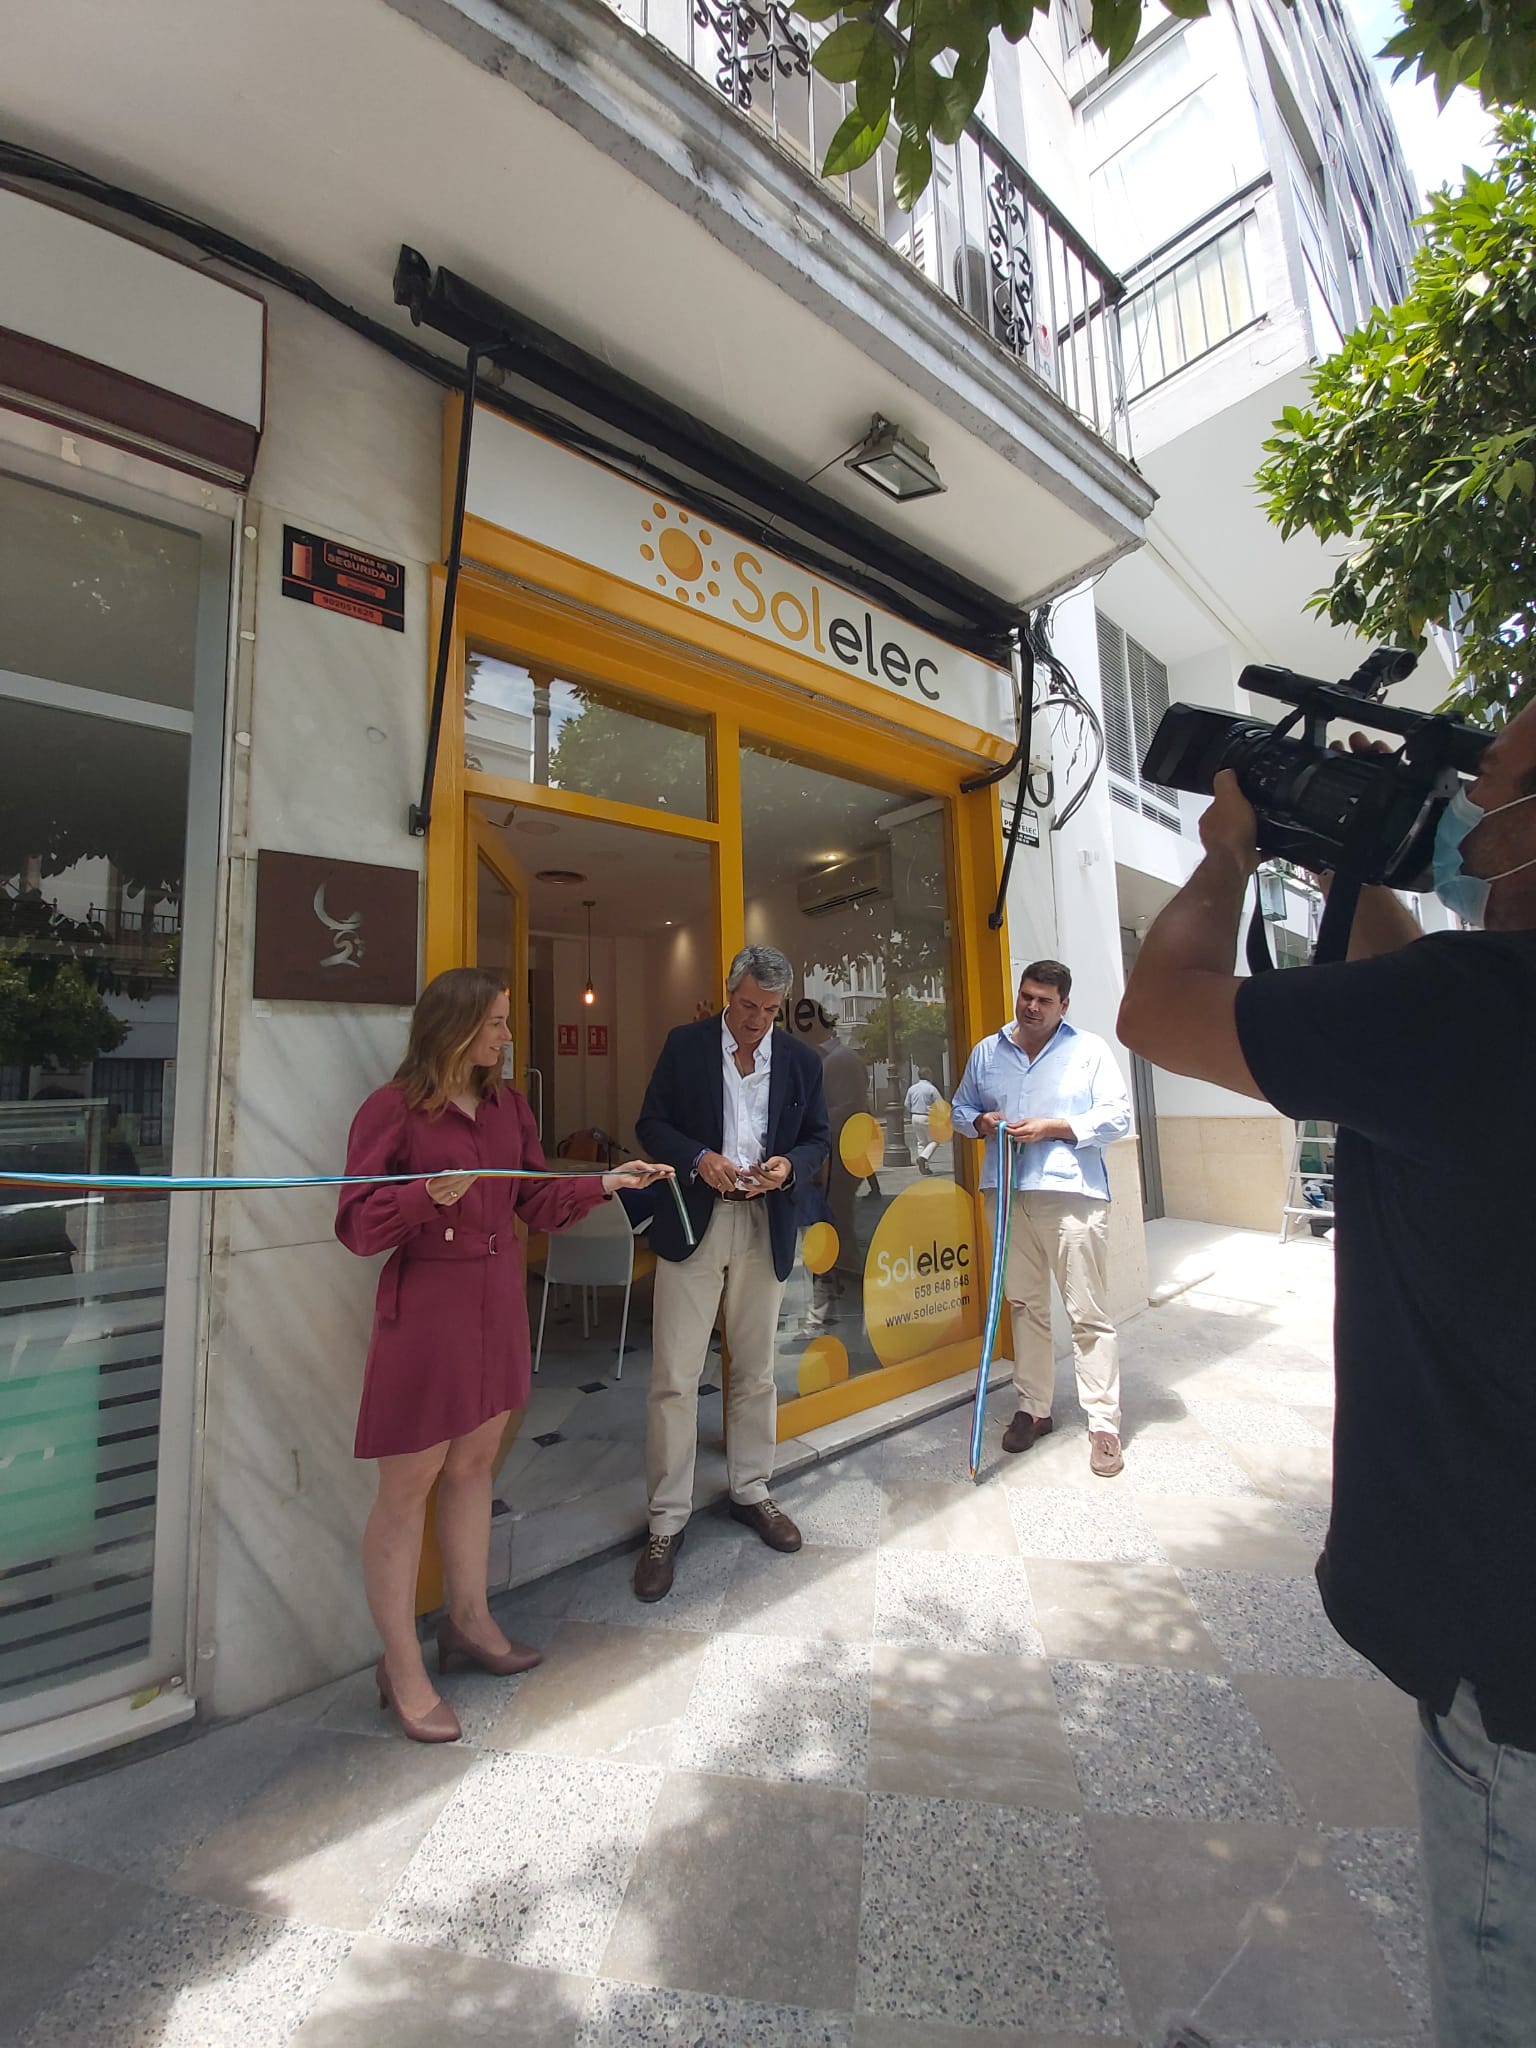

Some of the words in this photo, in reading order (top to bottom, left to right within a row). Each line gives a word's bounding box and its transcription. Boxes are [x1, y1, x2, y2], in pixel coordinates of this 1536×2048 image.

[327, 553, 395, 583] SEGURIDAD
[732, 551, 940, 701] Solelec
[877, 1239, 970, 1288] Solelec
[914, 1283, 932, 1299] 658
[934, 1278, 951, 1294] 648
[953, 1274, 969, 1289] 648
[885, 1295, 970, 1328] www.solelec.com
